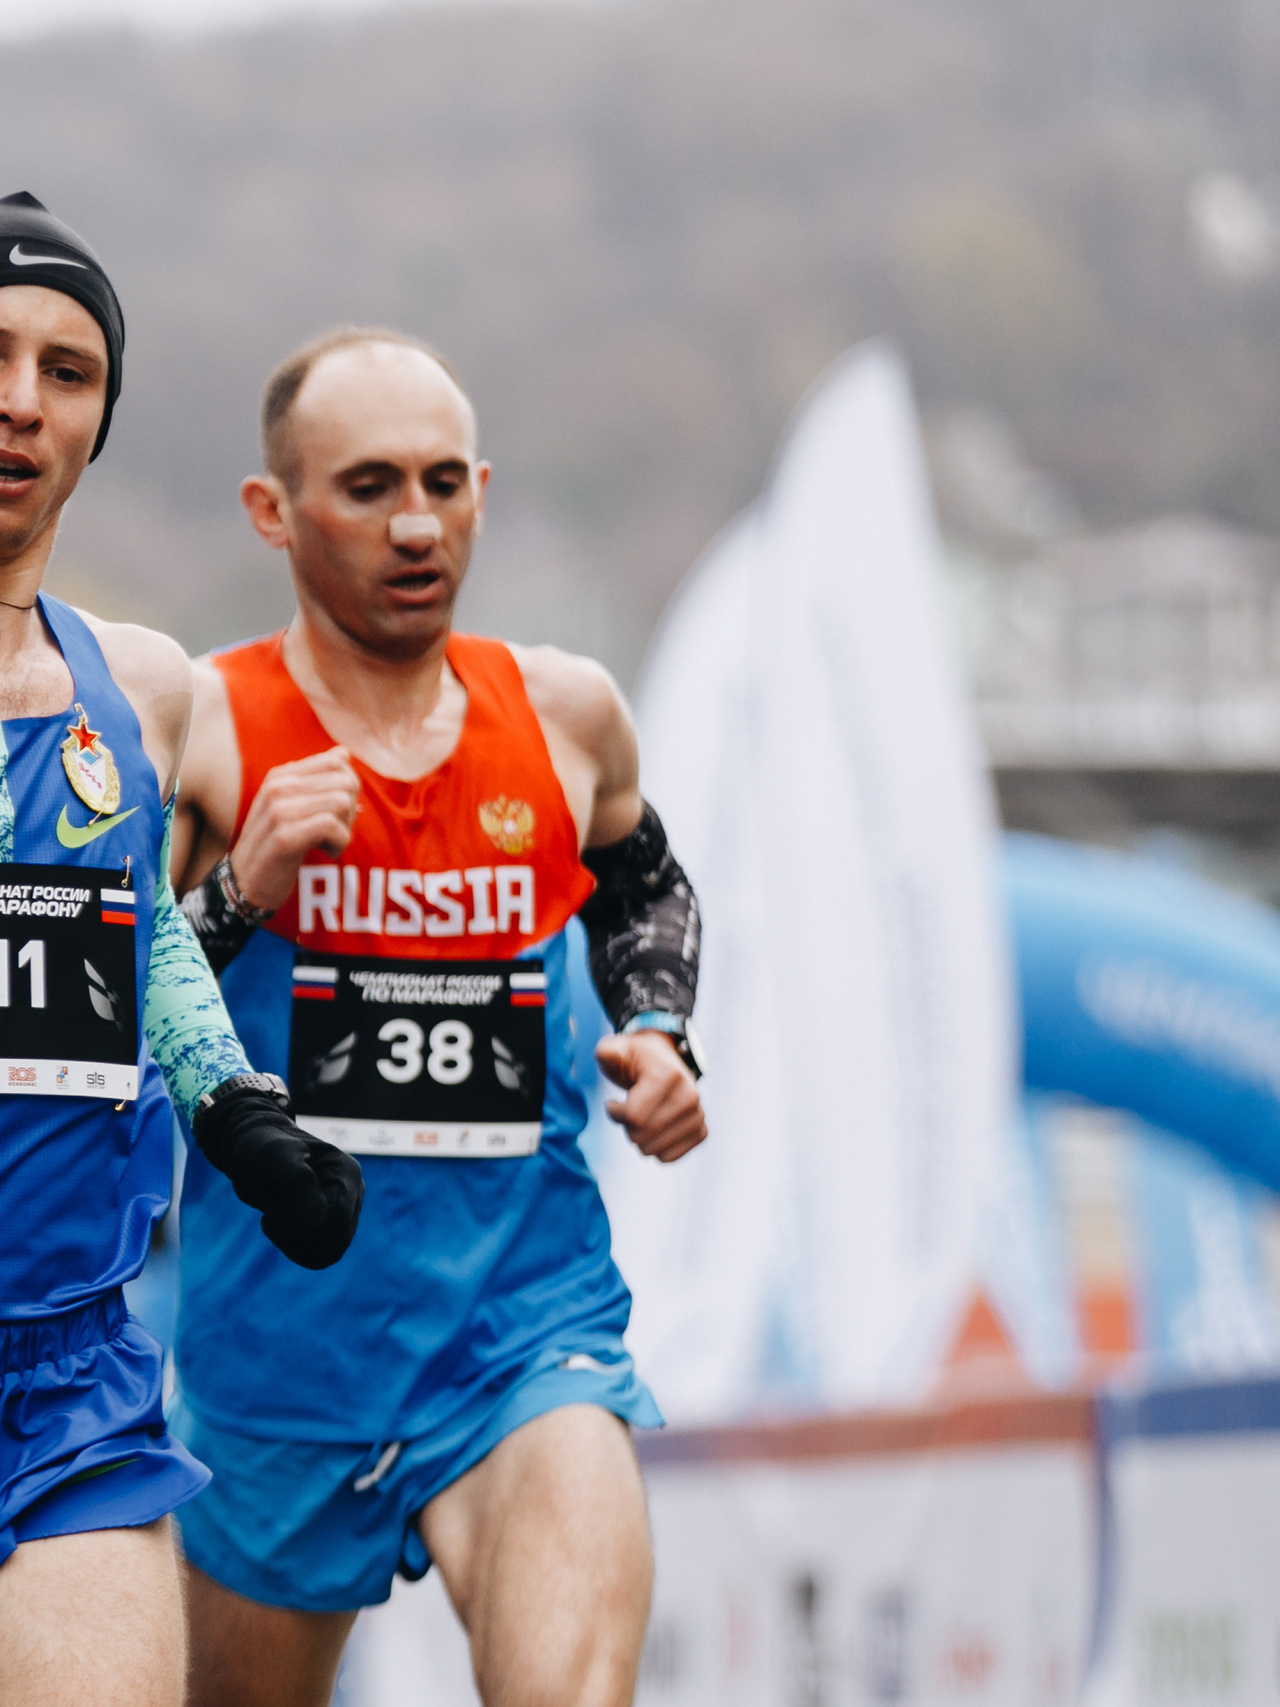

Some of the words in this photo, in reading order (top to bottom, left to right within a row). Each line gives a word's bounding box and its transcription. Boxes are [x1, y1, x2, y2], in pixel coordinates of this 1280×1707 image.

[32, 886, 91, 903] РОССИИ
[298, 864, 535, 936] RUSSIA
[362, 986, 391, 1003] ПО
[376, 1018, 473, 1085] 38
